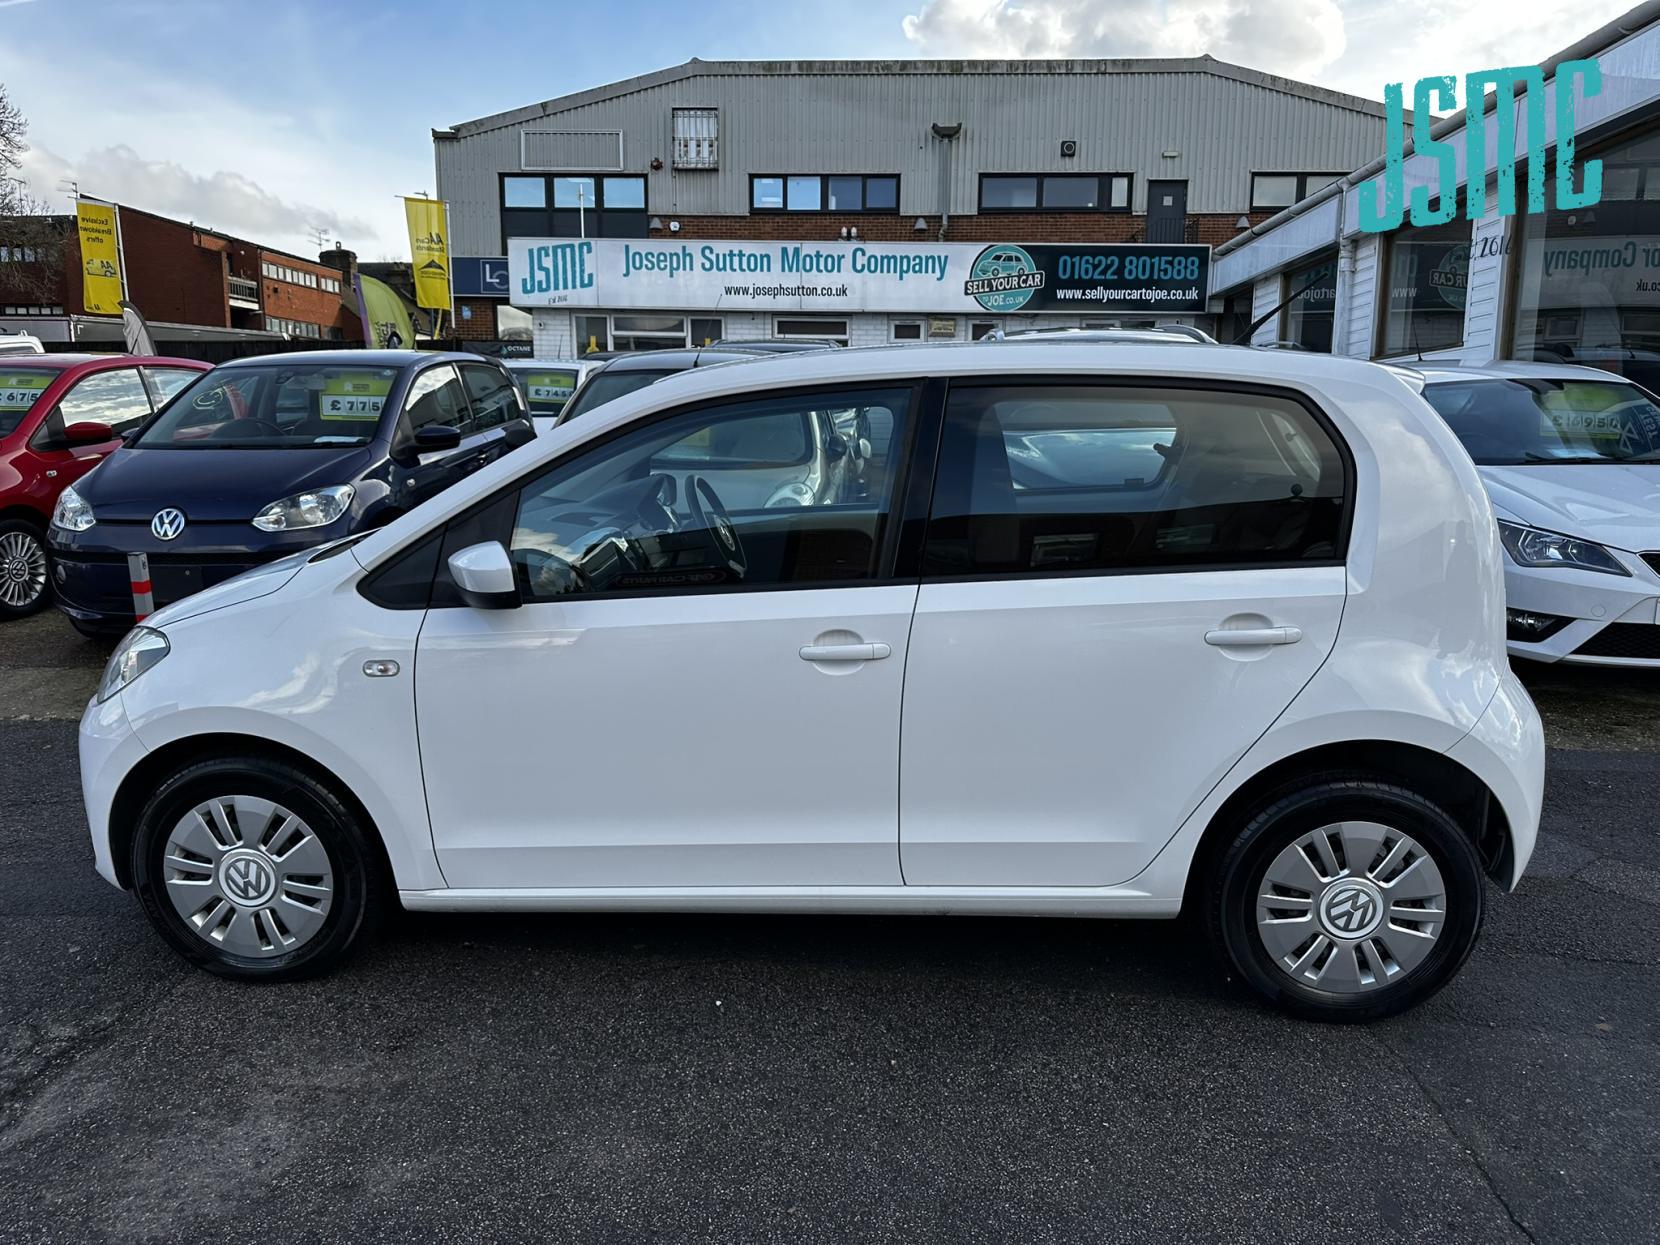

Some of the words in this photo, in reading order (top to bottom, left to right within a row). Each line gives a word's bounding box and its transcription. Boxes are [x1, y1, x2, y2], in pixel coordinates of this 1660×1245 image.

[521, 241, 594, 295] JSMC
[622, 244, 694, 278] Joseph
[701, 245, 772, 273] Sutton
[781, 246, 845, 274] Motor
[851, 247, 949, 281] Company
[1058, 255, 1118, 280] 01622
[1124, 256, 1199, 280] 801588
[724, 283, 848, 299] www.josephsutton.co.uk
[966, 280, 990, 294] SELL
[991, 276, 1019, 291] YOUR
[1020, 274, 1041, 287] CAR
[1056, 286, 1199, 304] www.sellyourcartojoe.co.uk
[0, 392, 39, 402] 675
[330, 400, 380, 412] £775
[152, 508, 185, 540] VW
